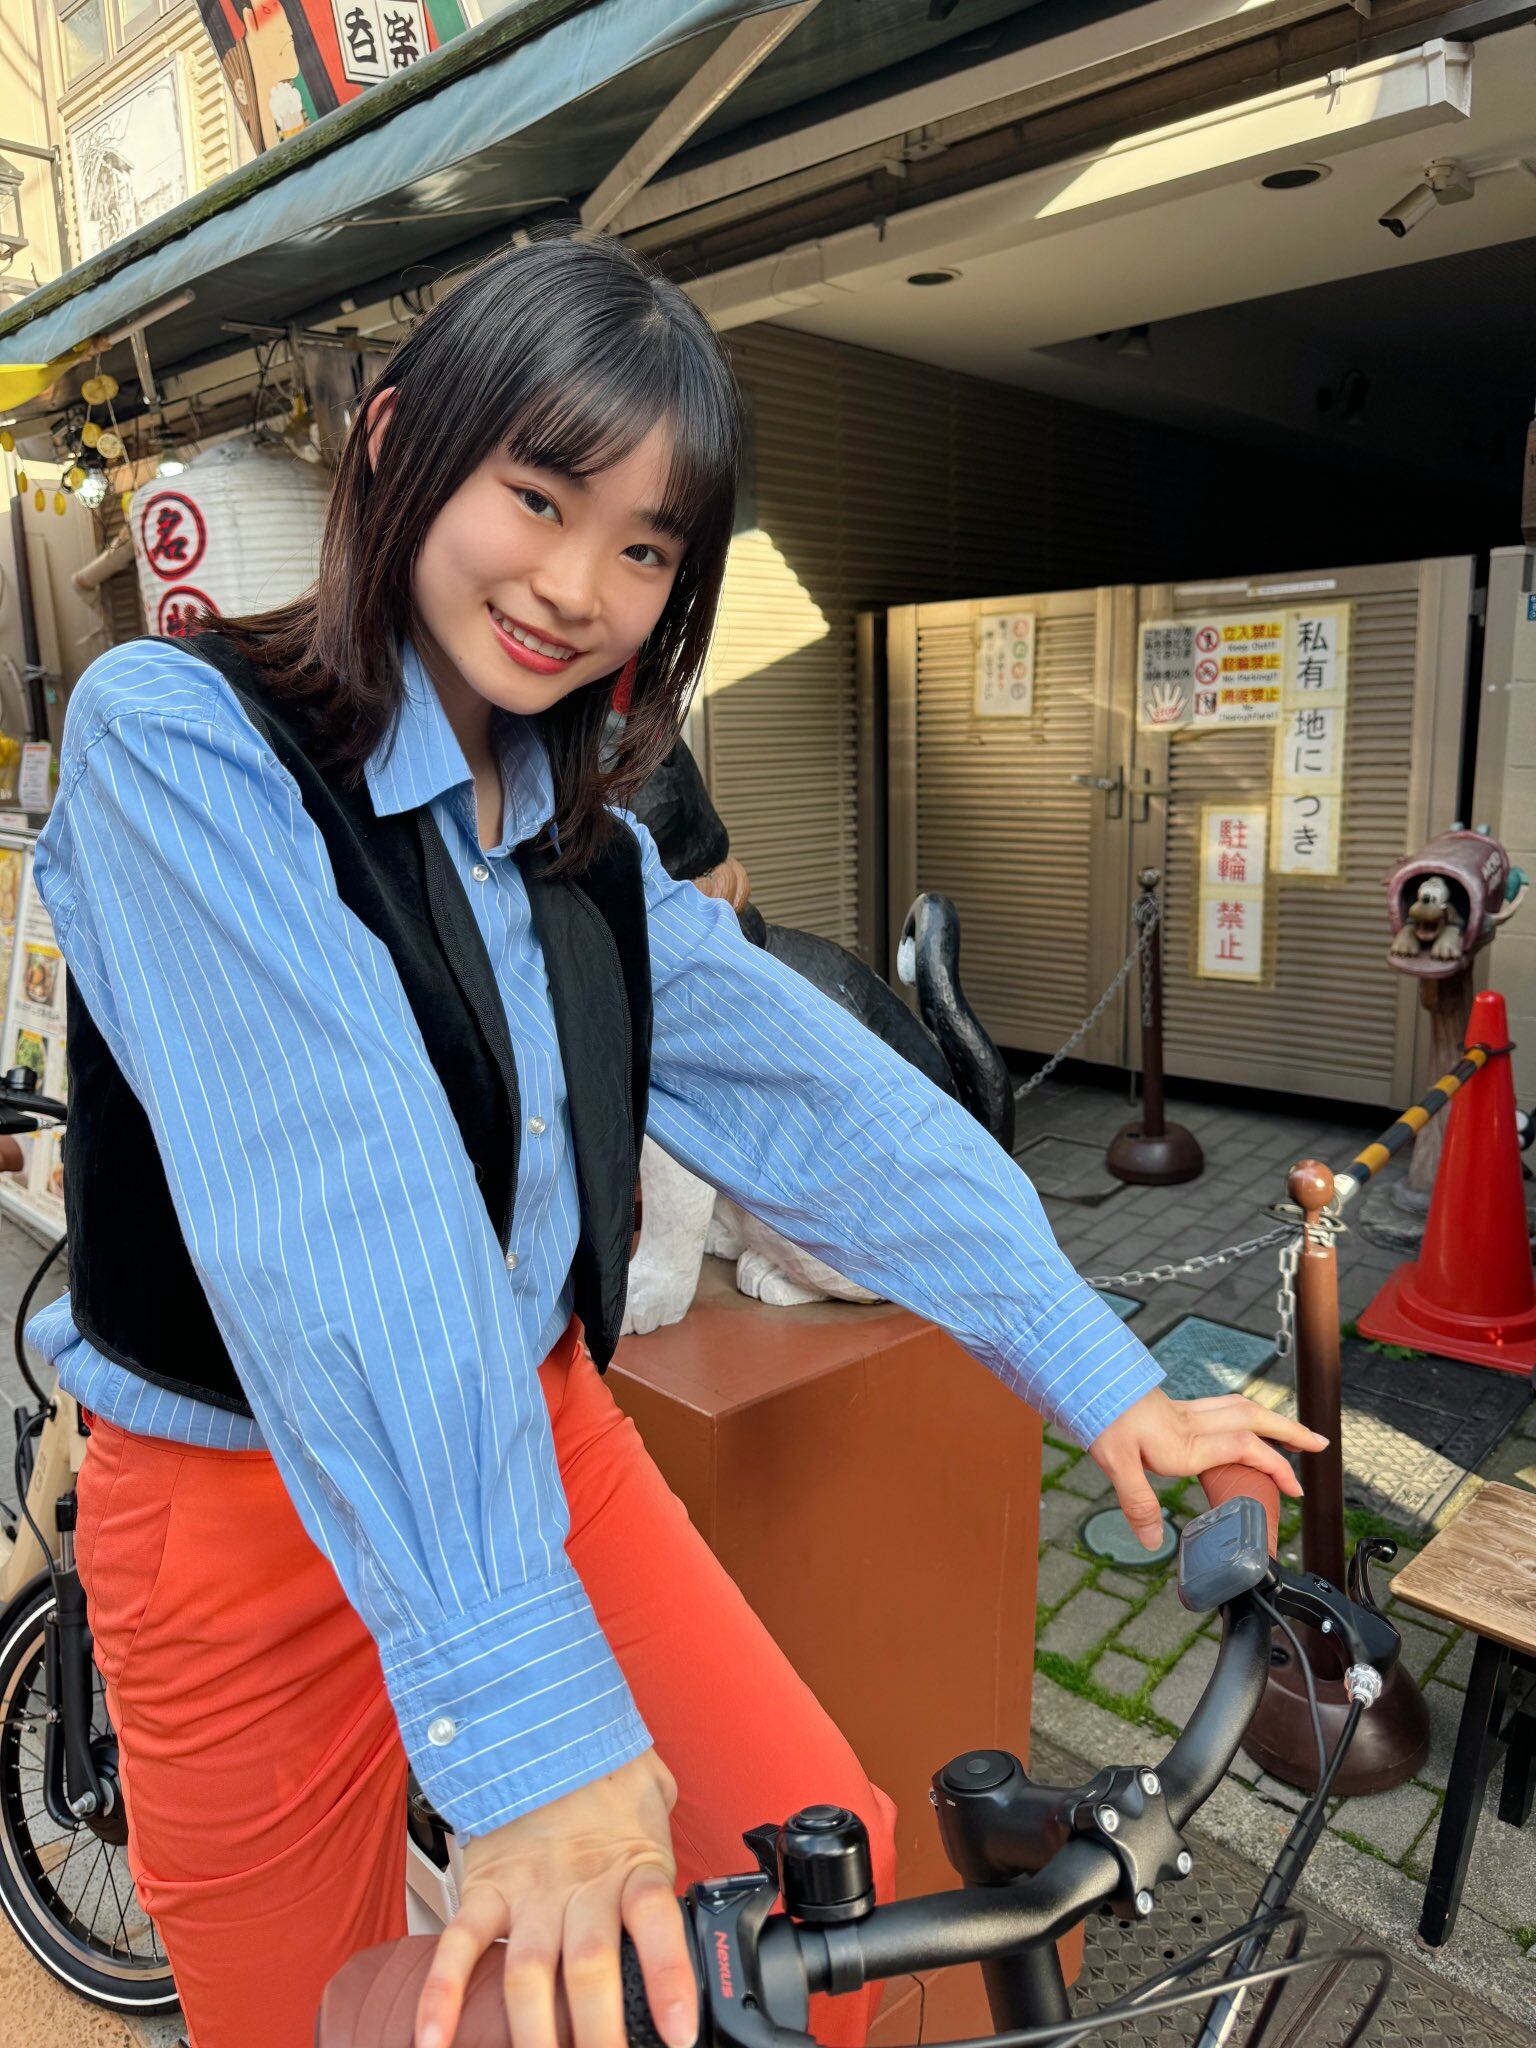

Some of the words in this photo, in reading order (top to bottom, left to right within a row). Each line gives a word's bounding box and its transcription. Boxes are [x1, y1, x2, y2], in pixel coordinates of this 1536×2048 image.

[1222, 624, 1281, 641] 立入禁止
[1294, 621, 1328, 855] 私有地につき
[1215, 819, 1248, 960] 駐輪禁止
